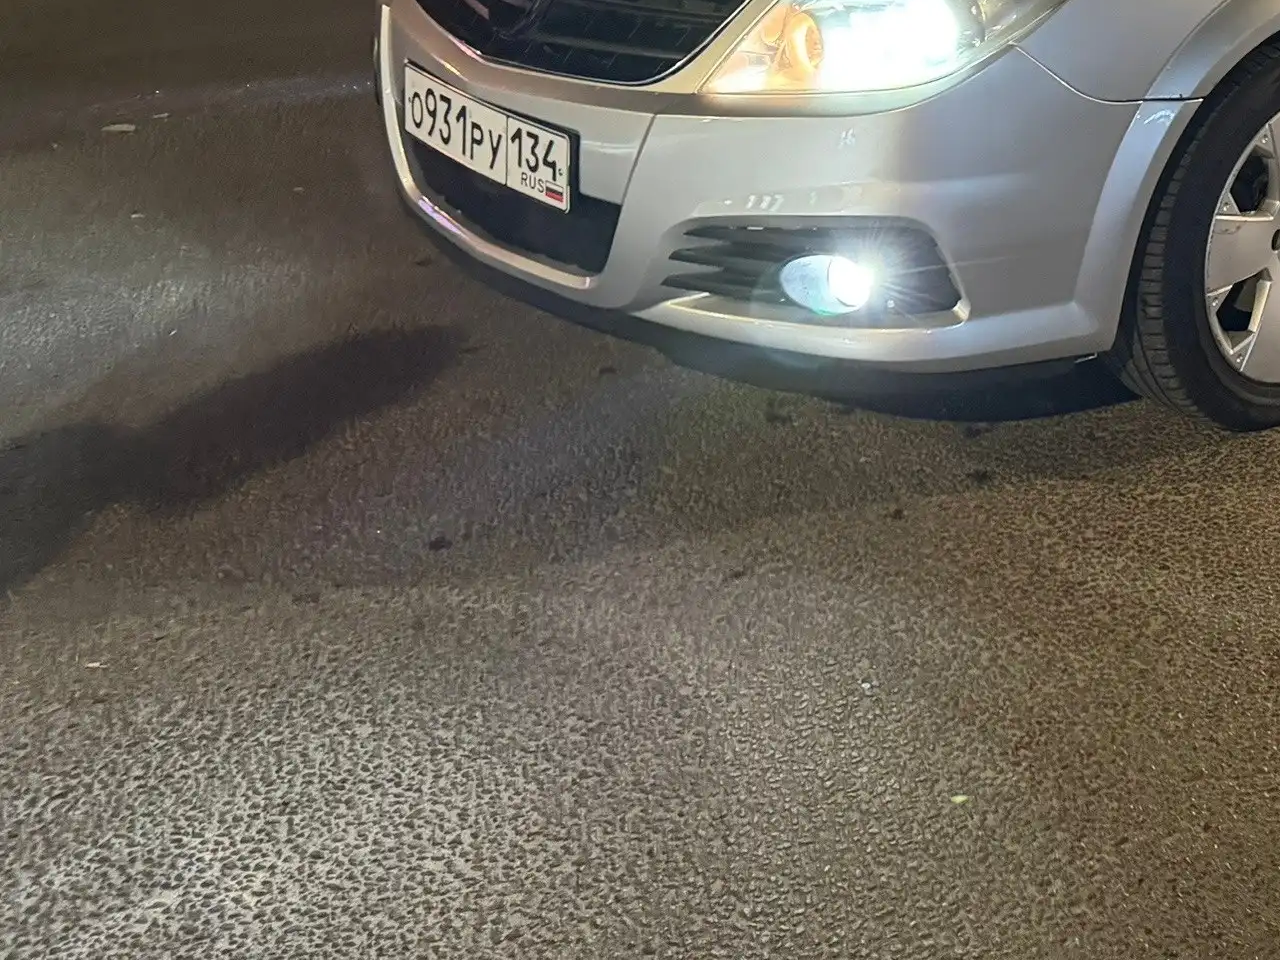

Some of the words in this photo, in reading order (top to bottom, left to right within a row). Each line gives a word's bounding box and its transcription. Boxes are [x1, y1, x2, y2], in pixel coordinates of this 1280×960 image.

[411, 88, 502, 170] О931РУ
[510, 127, 557, 182] 134
[520, 171, 545, 194] RUS
